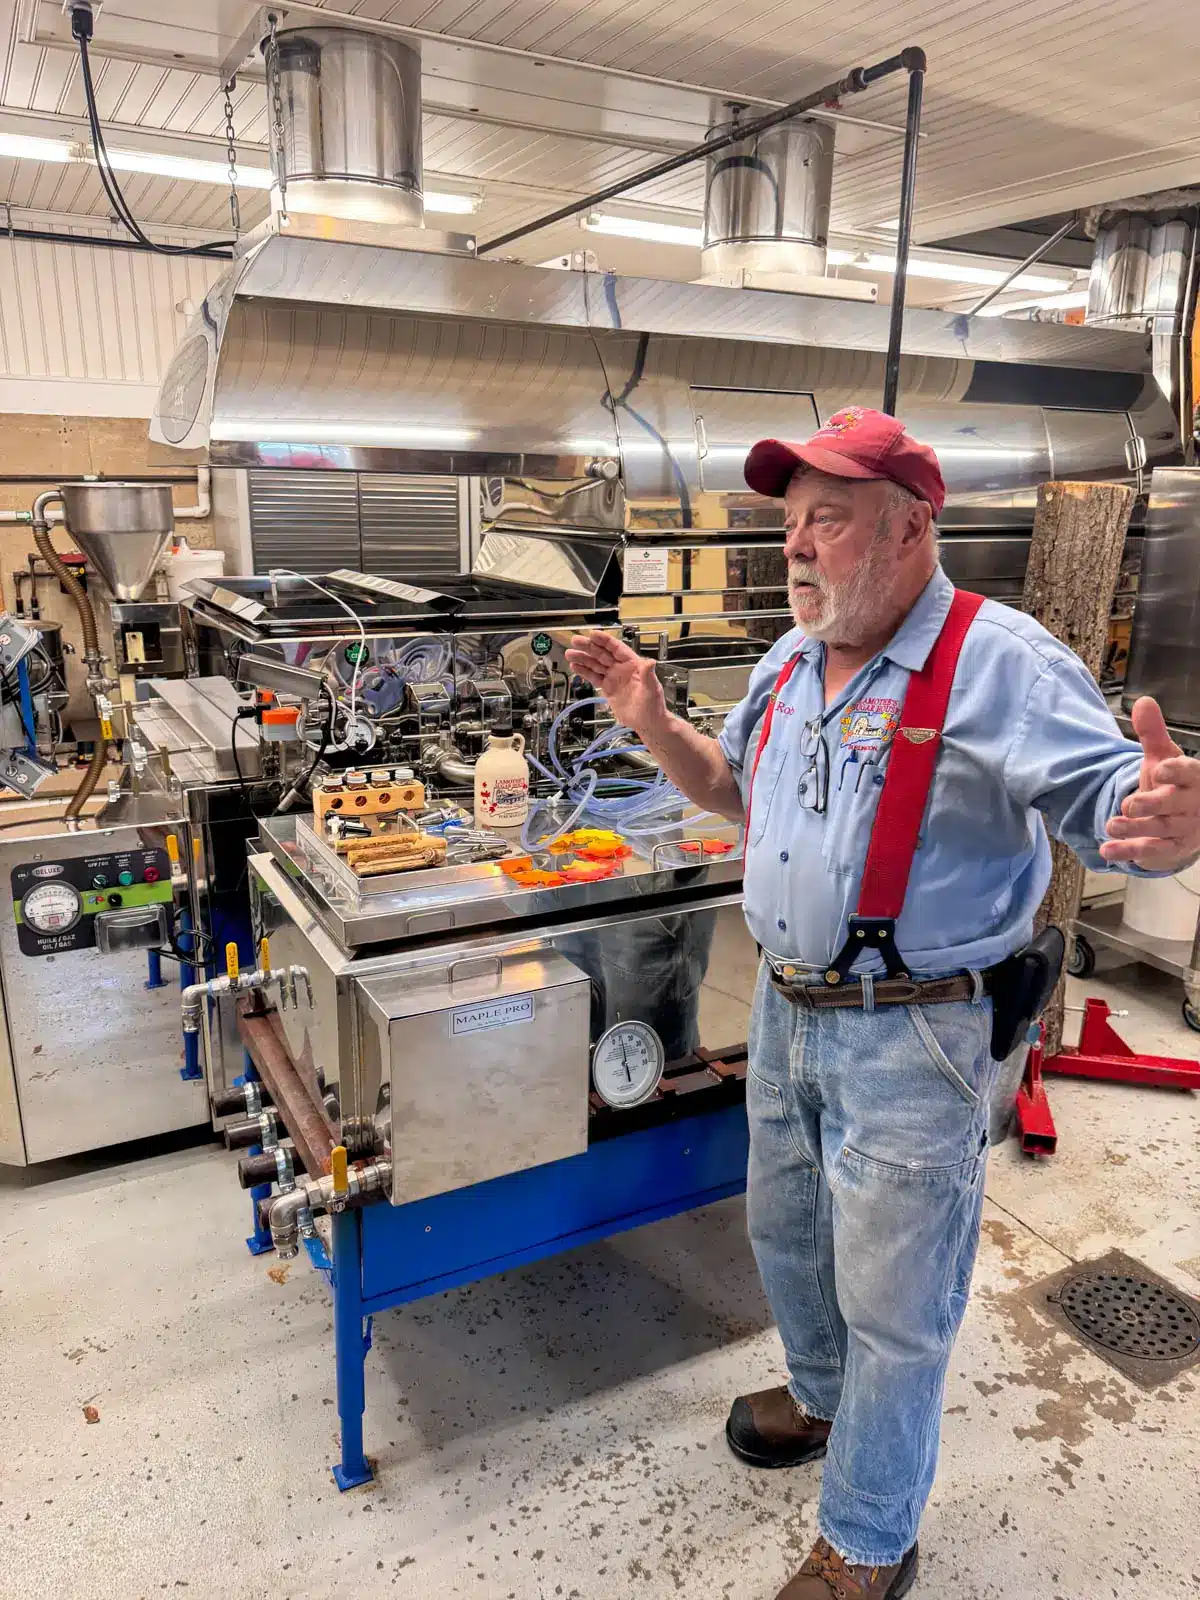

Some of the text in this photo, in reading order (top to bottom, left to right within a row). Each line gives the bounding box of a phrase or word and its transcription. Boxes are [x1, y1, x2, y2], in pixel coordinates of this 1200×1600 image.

[775, 701, 795, 716] Rob
[35, 867, 61, 875] DELUXE
[37, 936, 57, 945] HUILE
[58, 940, 72, 948] GAS
[456, 1009, 502, 1025] MAPLE
[505, 1003, 531, 1014] PRO
